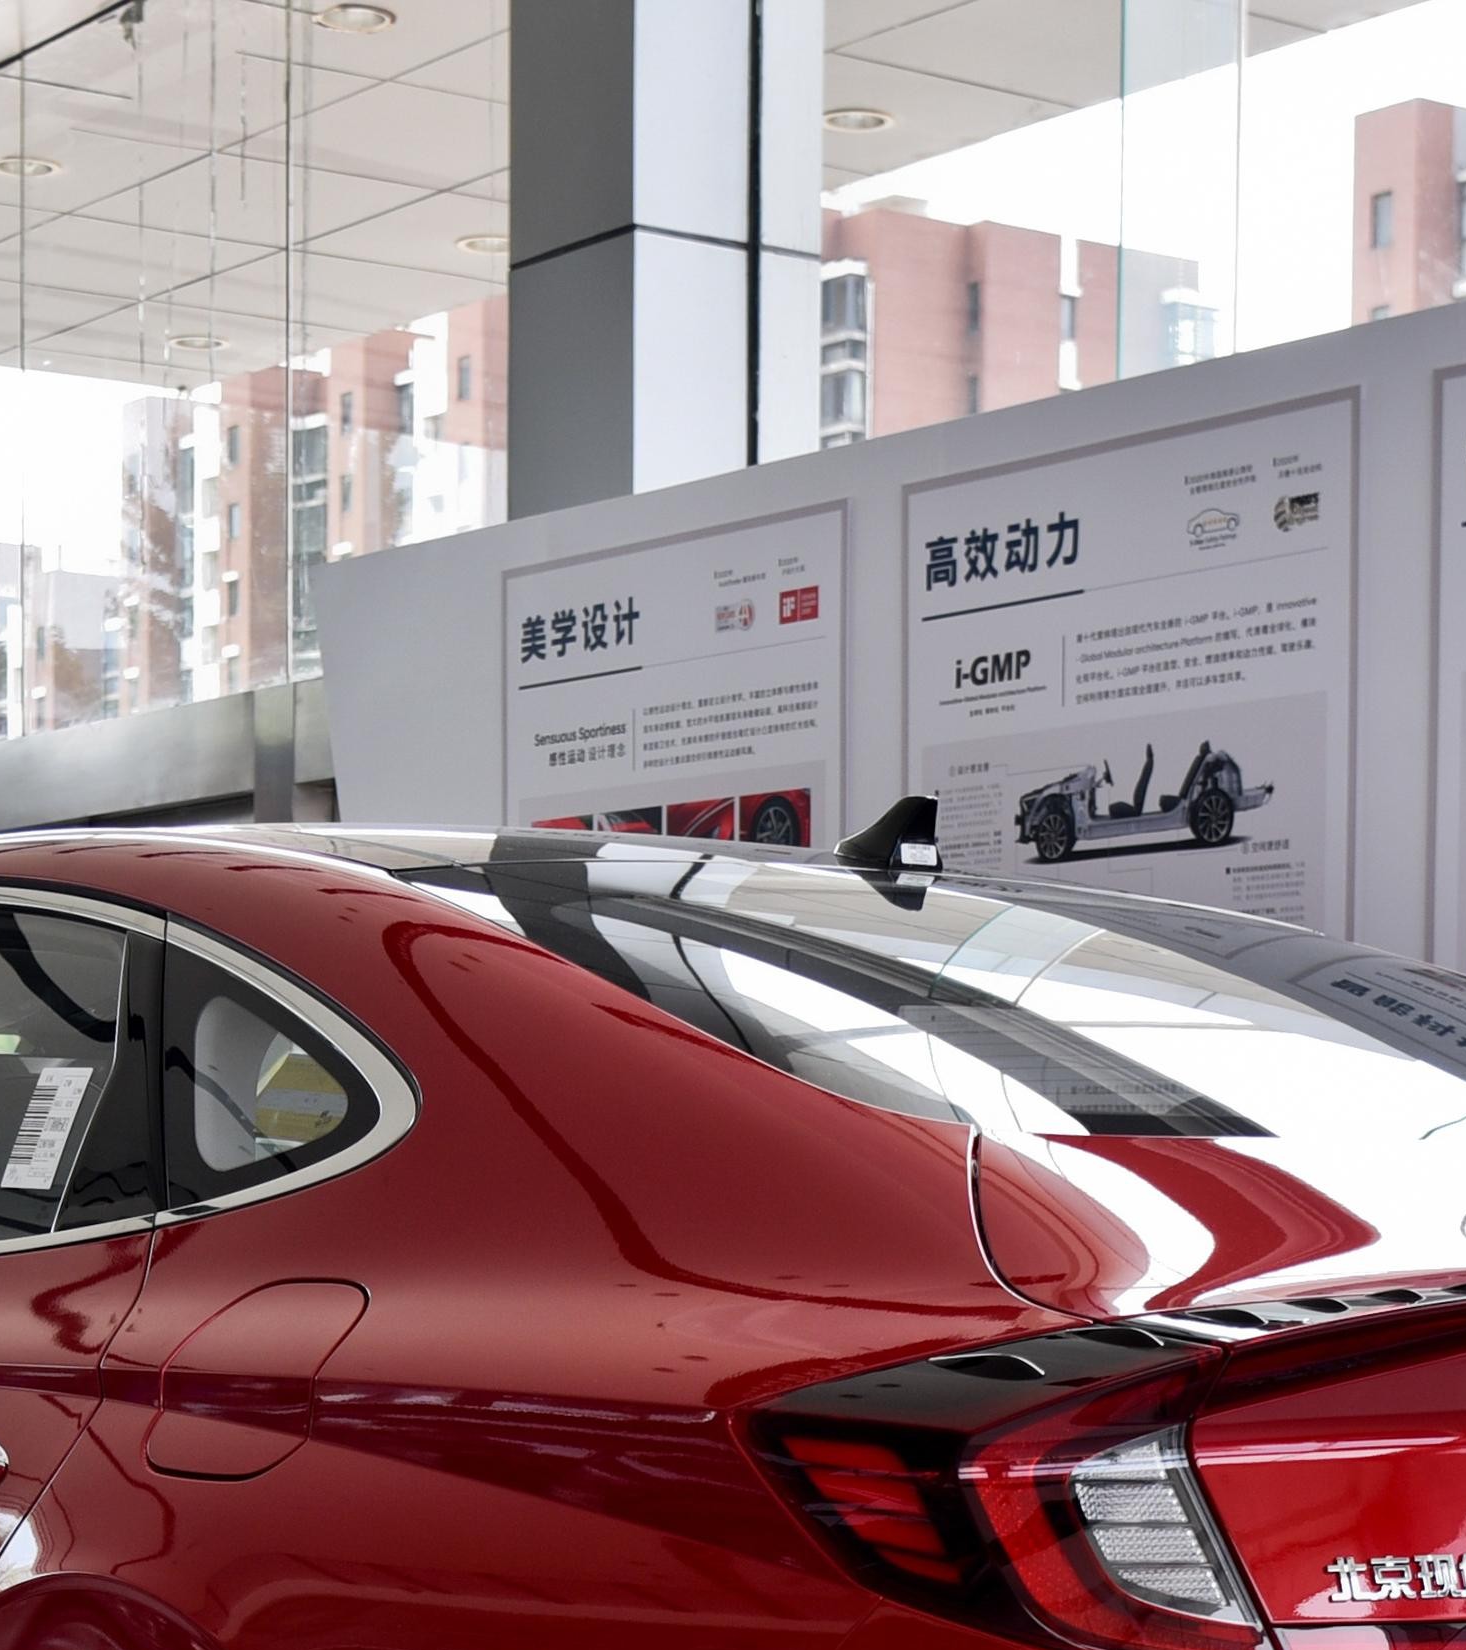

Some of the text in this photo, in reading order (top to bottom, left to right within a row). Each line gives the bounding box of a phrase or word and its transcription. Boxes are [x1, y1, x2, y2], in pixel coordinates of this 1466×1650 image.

[925, 511, 1080, 592] 高效动力
[520, 596, 640, 664] 美学设计
[954, 649, 1031, 689] i-GMP
[534, 727, 576, 747] Sensuous
[578, 722, 626, 744] Sportiness
